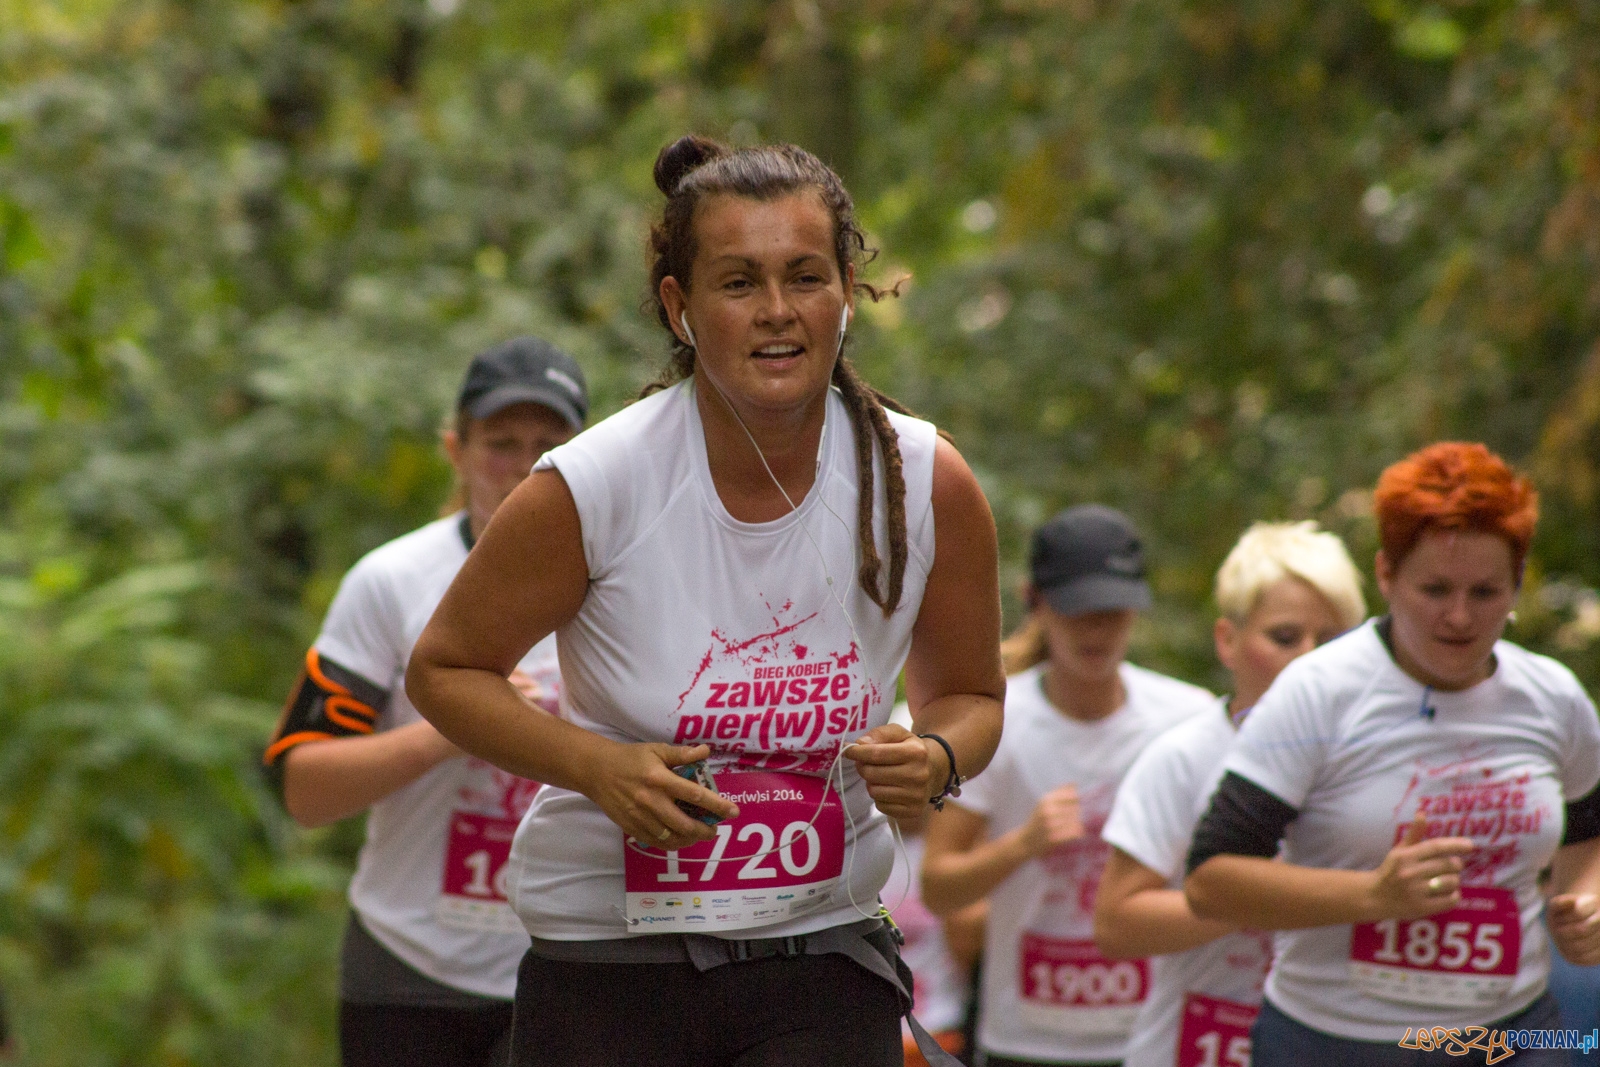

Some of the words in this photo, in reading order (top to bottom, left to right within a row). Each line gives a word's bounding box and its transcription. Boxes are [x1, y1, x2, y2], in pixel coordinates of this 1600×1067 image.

[754, 666, 784, 679] BIEG
[786, 661, 832, 678] KOBIET
[705, 673, 850, 708] zawsze
[673, 694, 869, 750] pier(w)si!
[773, 789, 803, 801] 2016
[1392, 808, 1541, 847] per(w)si!
[657, 821, 820, 882] 1720
[1373, 919, 1504, 971] 1855
[1031, 962, 1141, 1001] 1900
